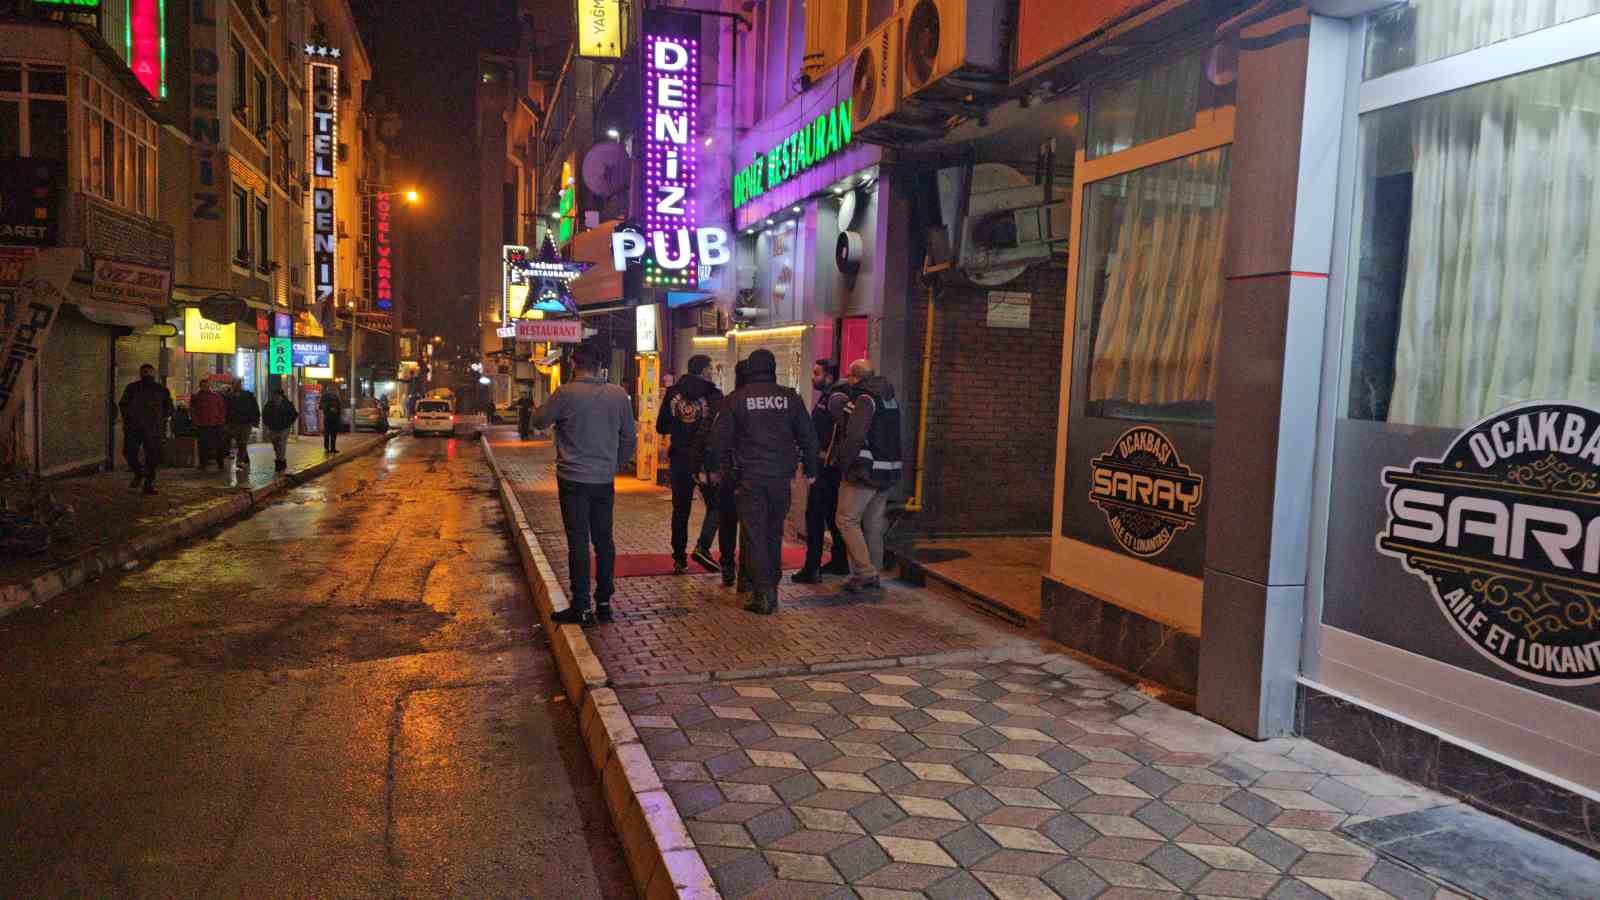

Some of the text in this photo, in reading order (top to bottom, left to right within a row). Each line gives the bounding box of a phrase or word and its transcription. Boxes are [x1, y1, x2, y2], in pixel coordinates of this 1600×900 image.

[612, 226, 730, 272] PUB
[519, 326, 576, 336] RESTAURANT
[276, 346, 285, 373] BAR
[1469, 412, 1600, 469] OCAKBA
[1094, 468, 1198, 512] SARAY
[1486, 624, 1516, 655] ET
